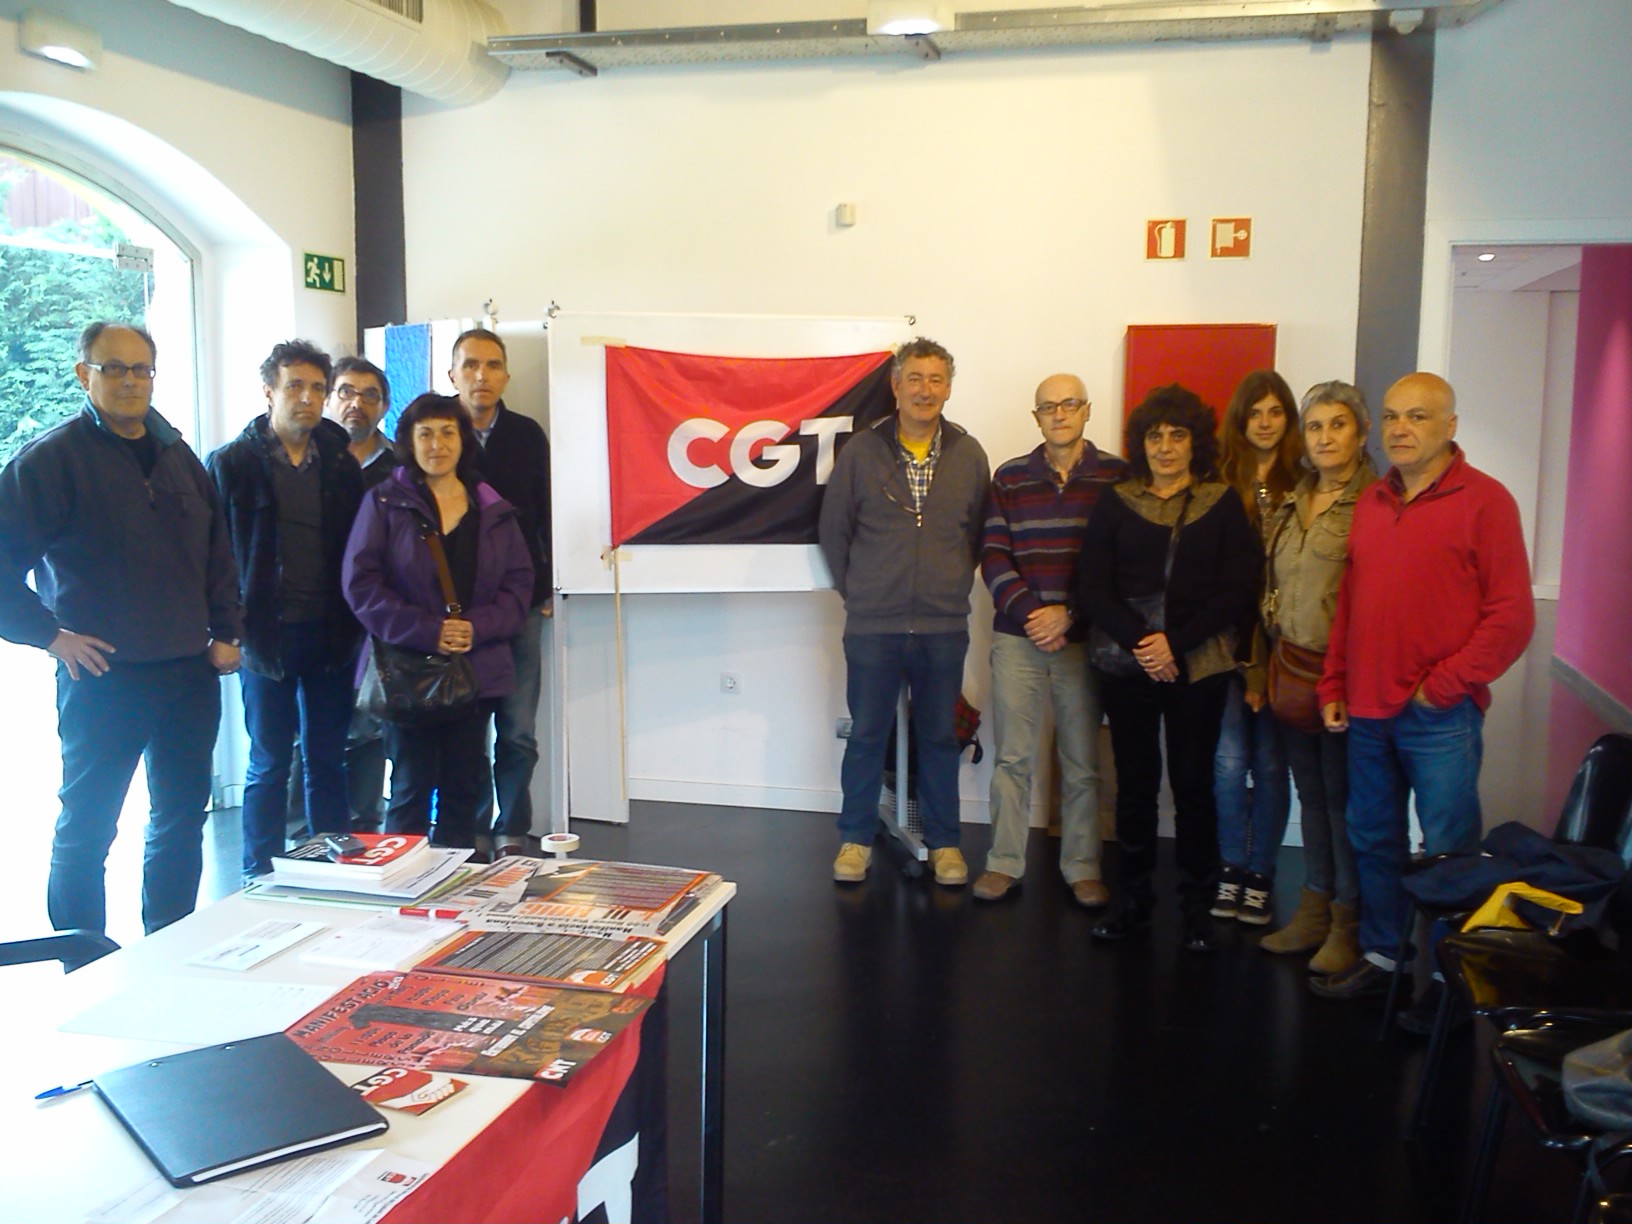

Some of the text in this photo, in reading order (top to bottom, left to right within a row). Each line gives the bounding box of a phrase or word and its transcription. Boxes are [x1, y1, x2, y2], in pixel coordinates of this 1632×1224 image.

[667, 415, 855, 489] CGT
[352, 836, 407, 865] CGT
[352, 1067, 408, 1097] CGT
[539, 1058, 577, 1080] CNT
